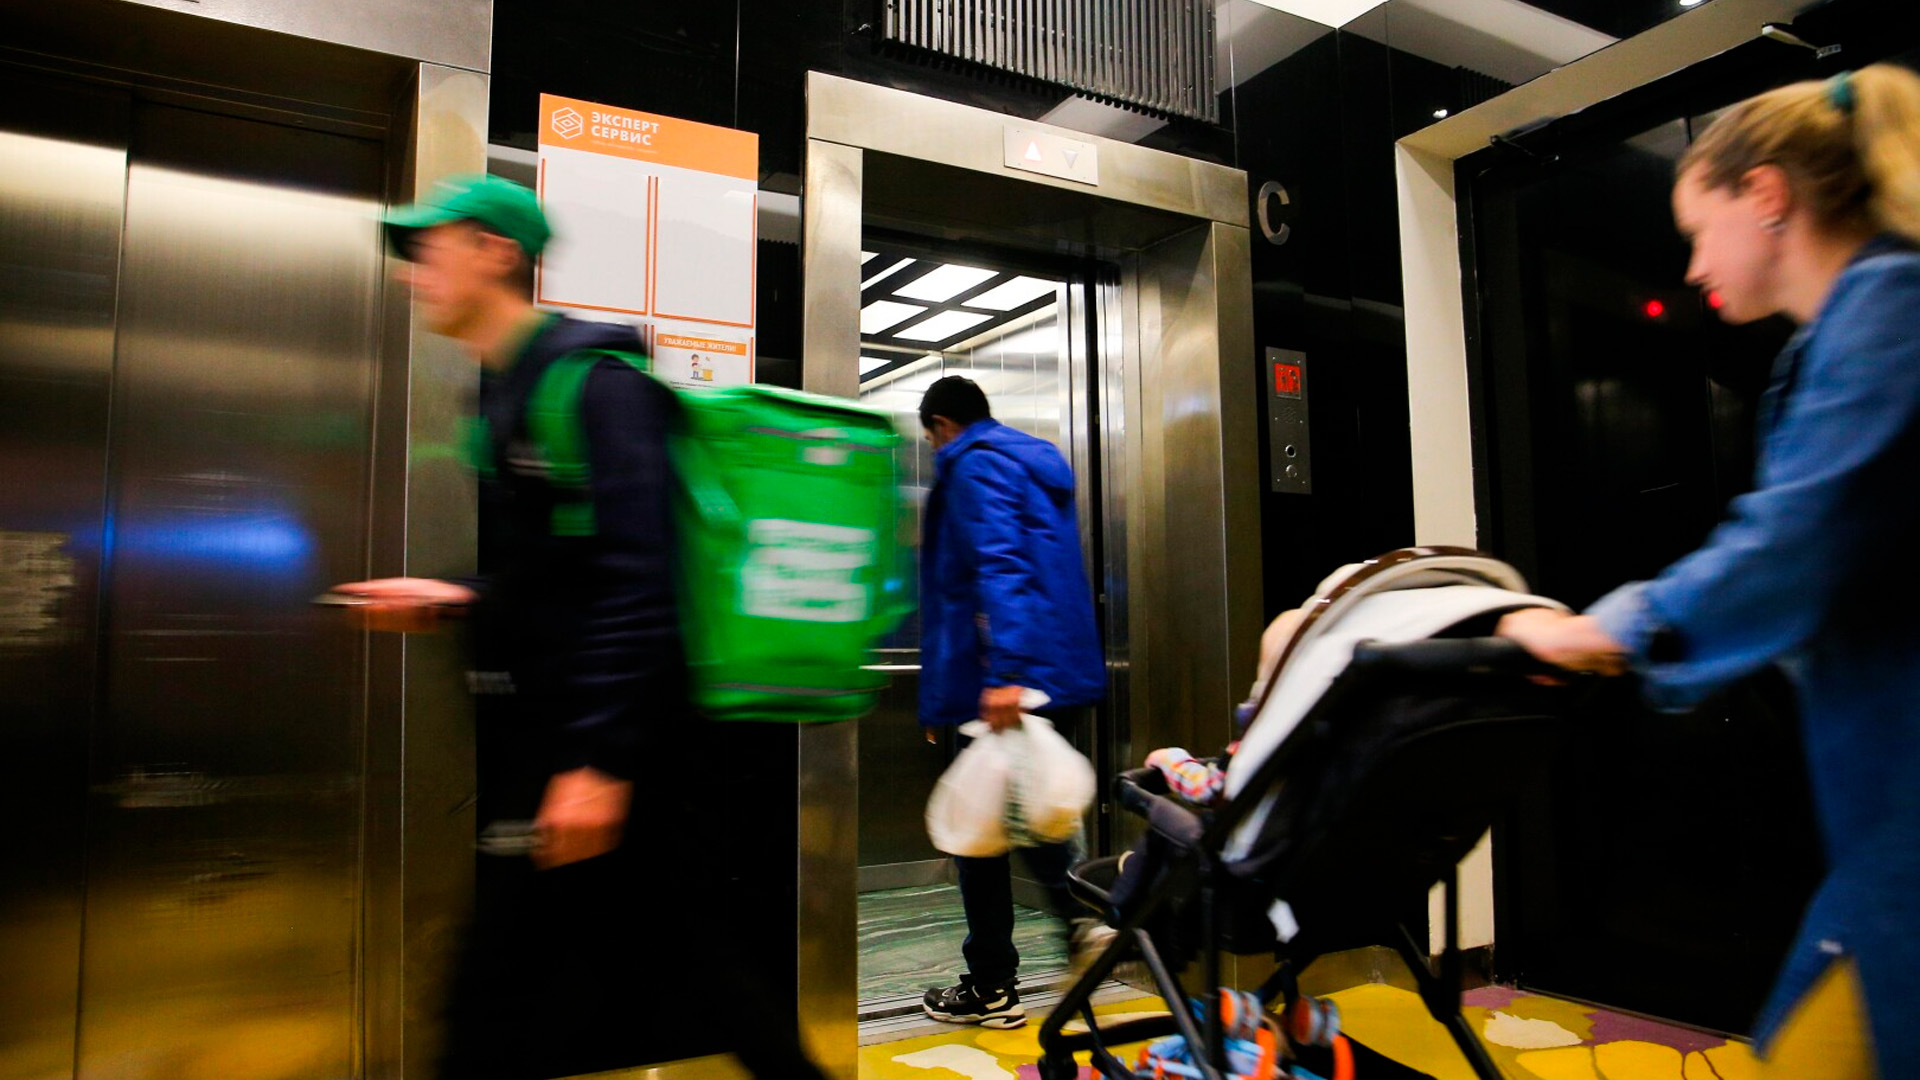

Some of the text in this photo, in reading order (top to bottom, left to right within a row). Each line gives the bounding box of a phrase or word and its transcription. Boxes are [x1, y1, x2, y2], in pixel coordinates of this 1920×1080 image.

[591, 111, 659, 134] ЭКСПЕРТ
[591, 125, 652, 146] СЕРВИС
[664, 337, 706, 349] УВАЖАЕМЫЕ
